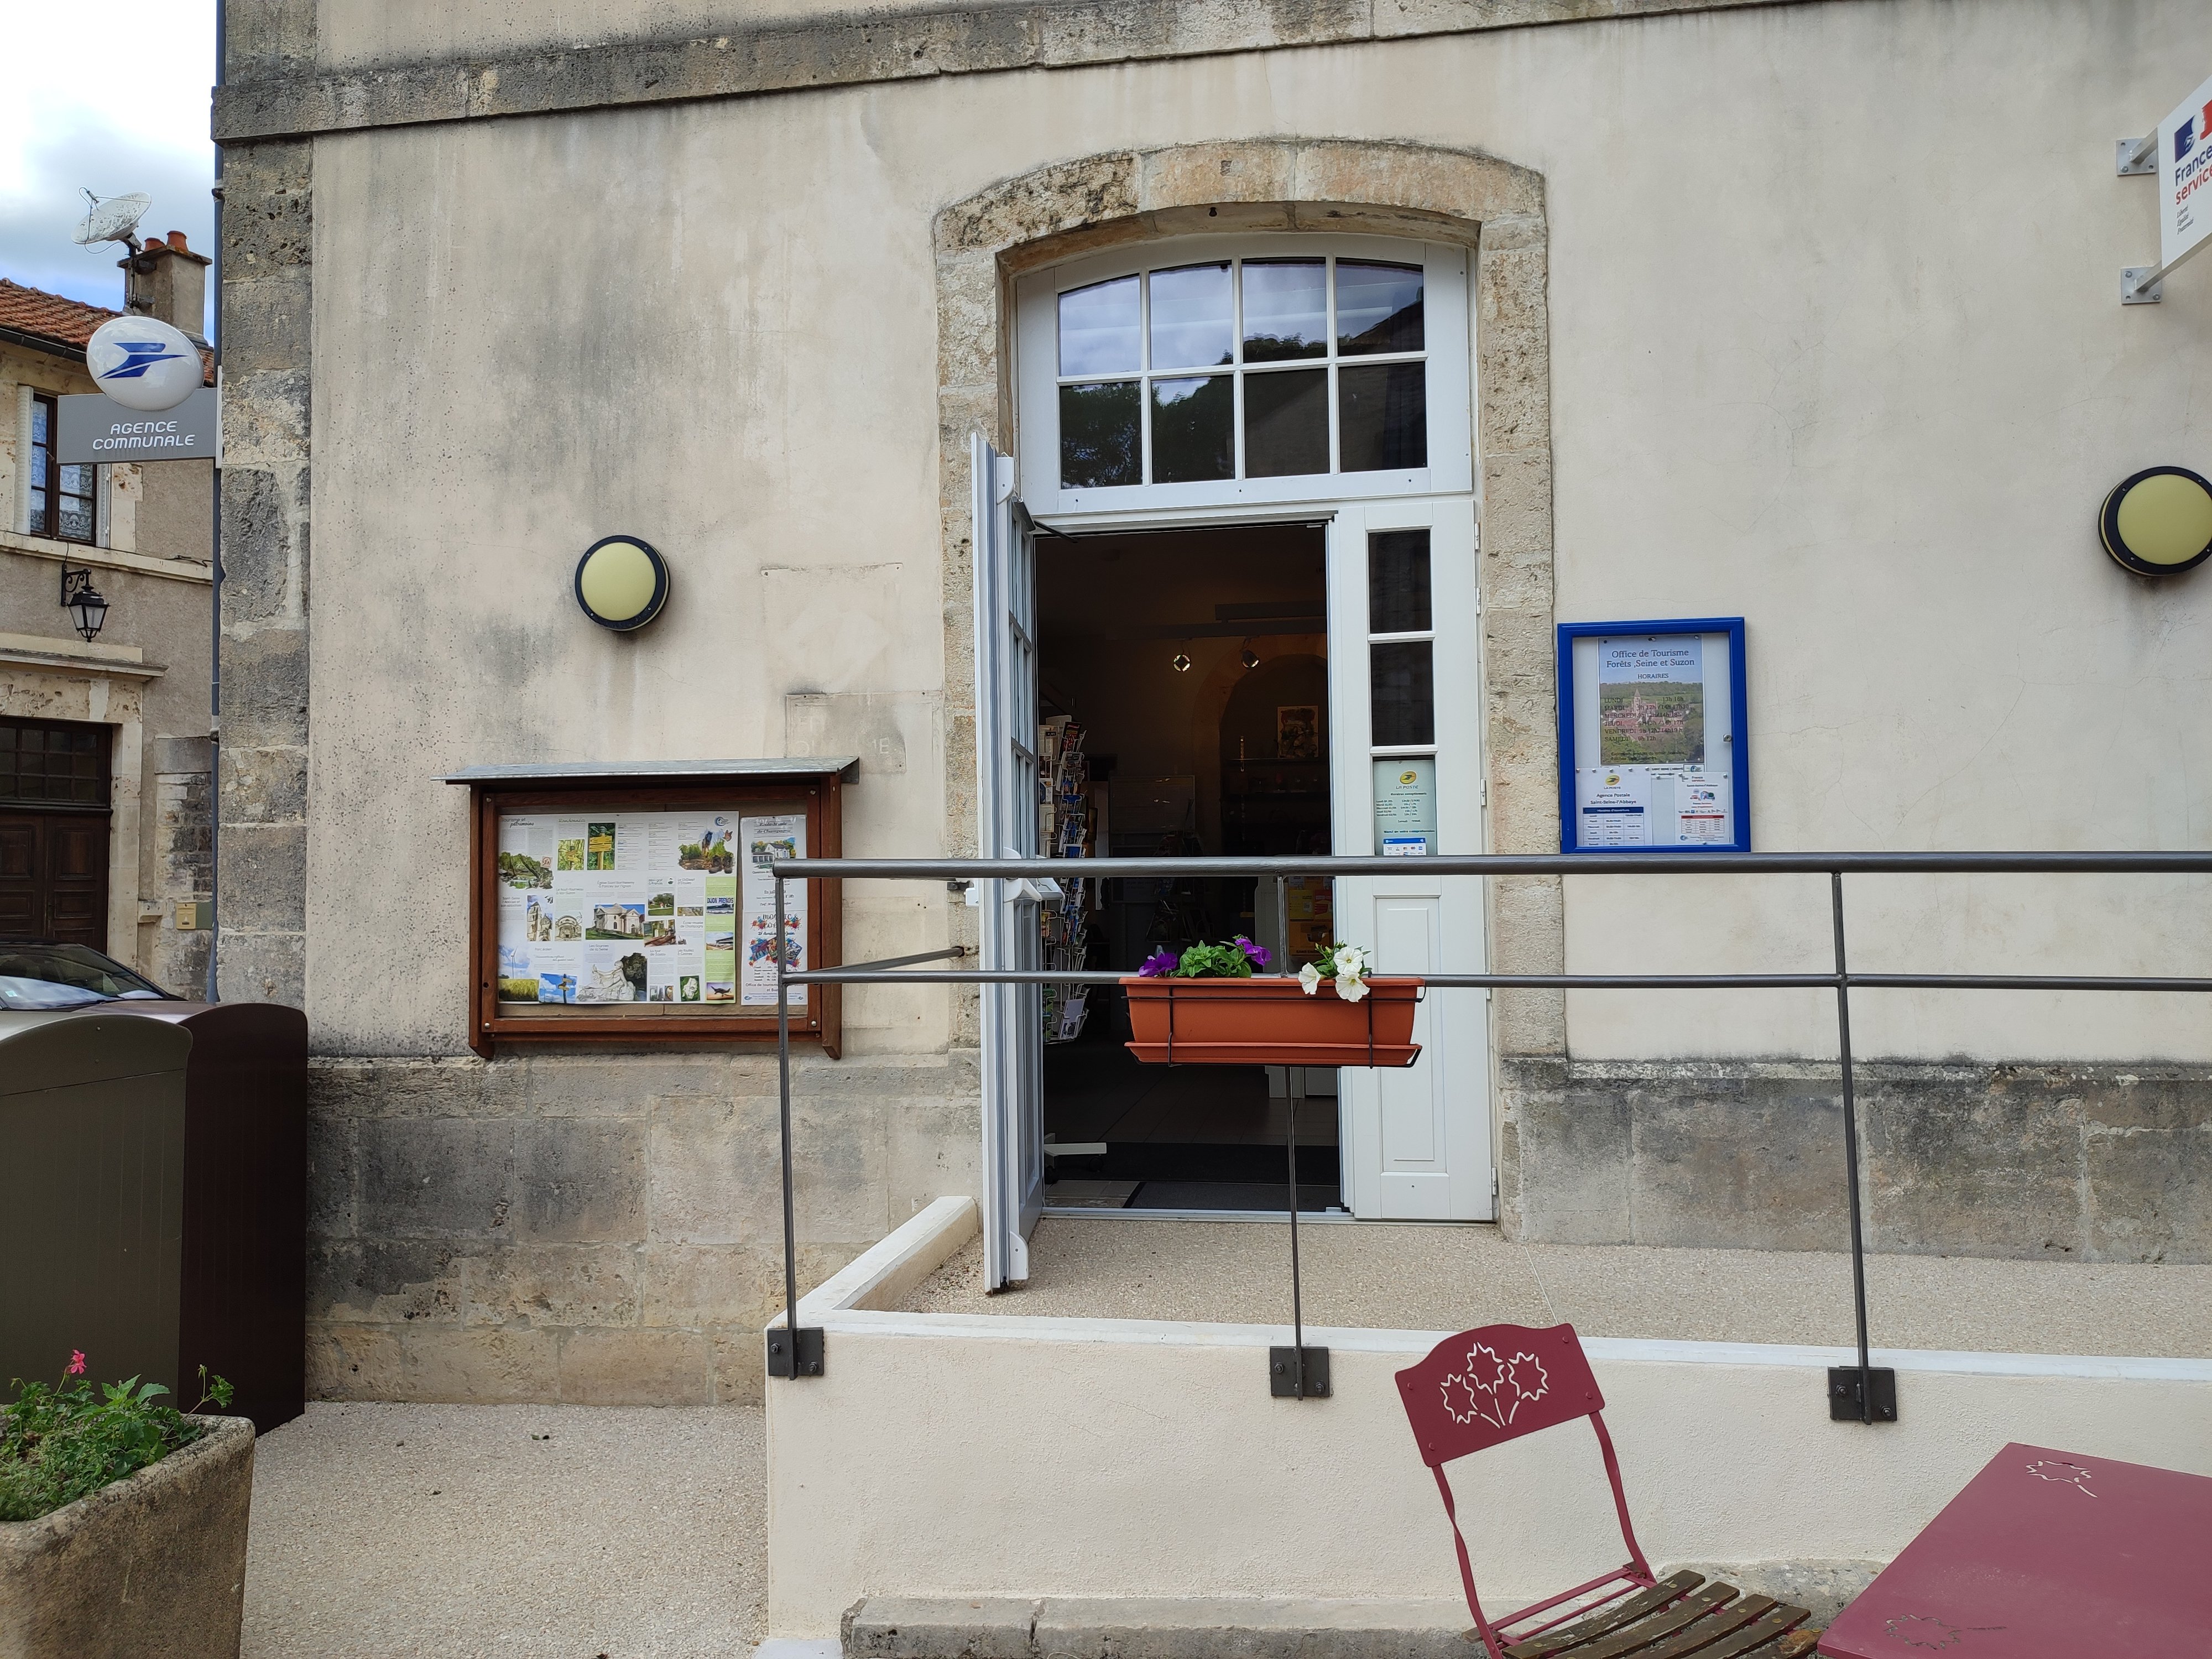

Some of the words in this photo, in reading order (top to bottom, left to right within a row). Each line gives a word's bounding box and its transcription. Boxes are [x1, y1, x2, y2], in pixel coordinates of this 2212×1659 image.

[2175, 145, 2212, 187] France
[110, 420, 178, 435] AGENCE
[92, 434, 195, 450] COMMUNALE
